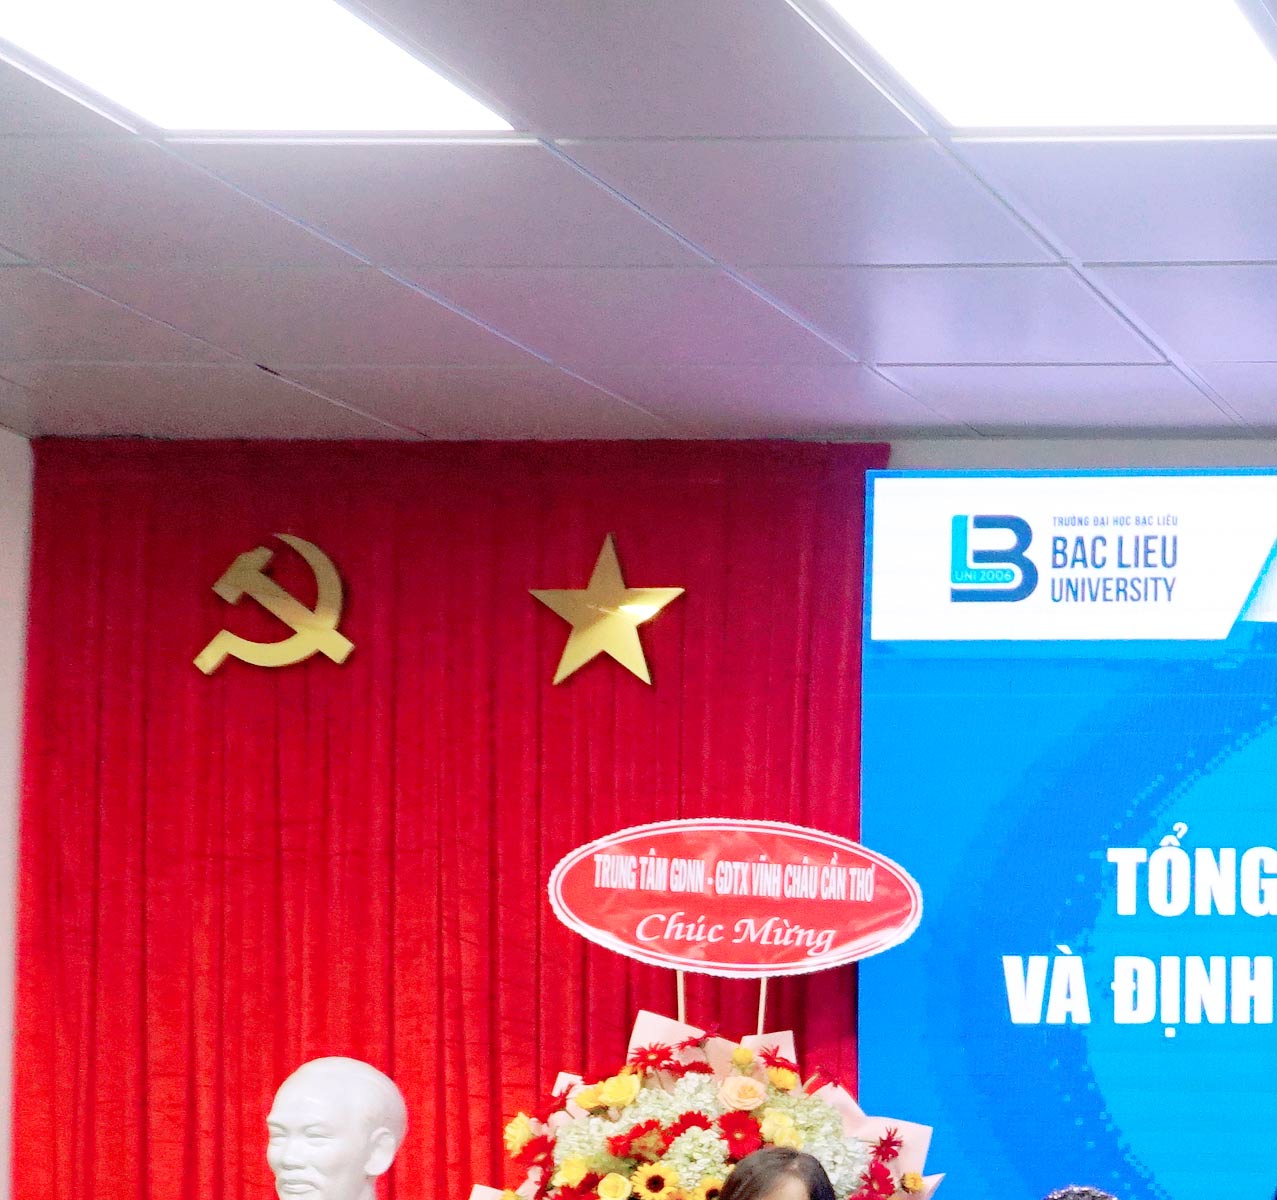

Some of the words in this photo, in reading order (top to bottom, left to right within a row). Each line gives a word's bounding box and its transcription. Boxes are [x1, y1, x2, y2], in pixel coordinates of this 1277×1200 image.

[1051, 535, 1107, 569] BAC
[1117, 535, 1178, 569] LIEU
[980, 570, 1011, 581] 2006
[1050, 577, 1176, 603] UNIVERSITY
[594, 854, 636, 889] TRUNG
[640, 848, 667, 891] TÂM
[670, 857, 705, 893] GDNN
[716, 861, 748, 896] GDTX
[752, 855, 781, 897] VĨNH
[784, 856, 818, 899] CHÂU
[821, 852, 847, 900] CẦN
[849, 863, 876, 902] THƠ
[635, 911, 724, 942] Chúc
[732, 917, 837, 956] Mừng
[1002, 945, 1091, 1025] VÀ
[1110, 955, 1274, 1037] ĐỊNH
